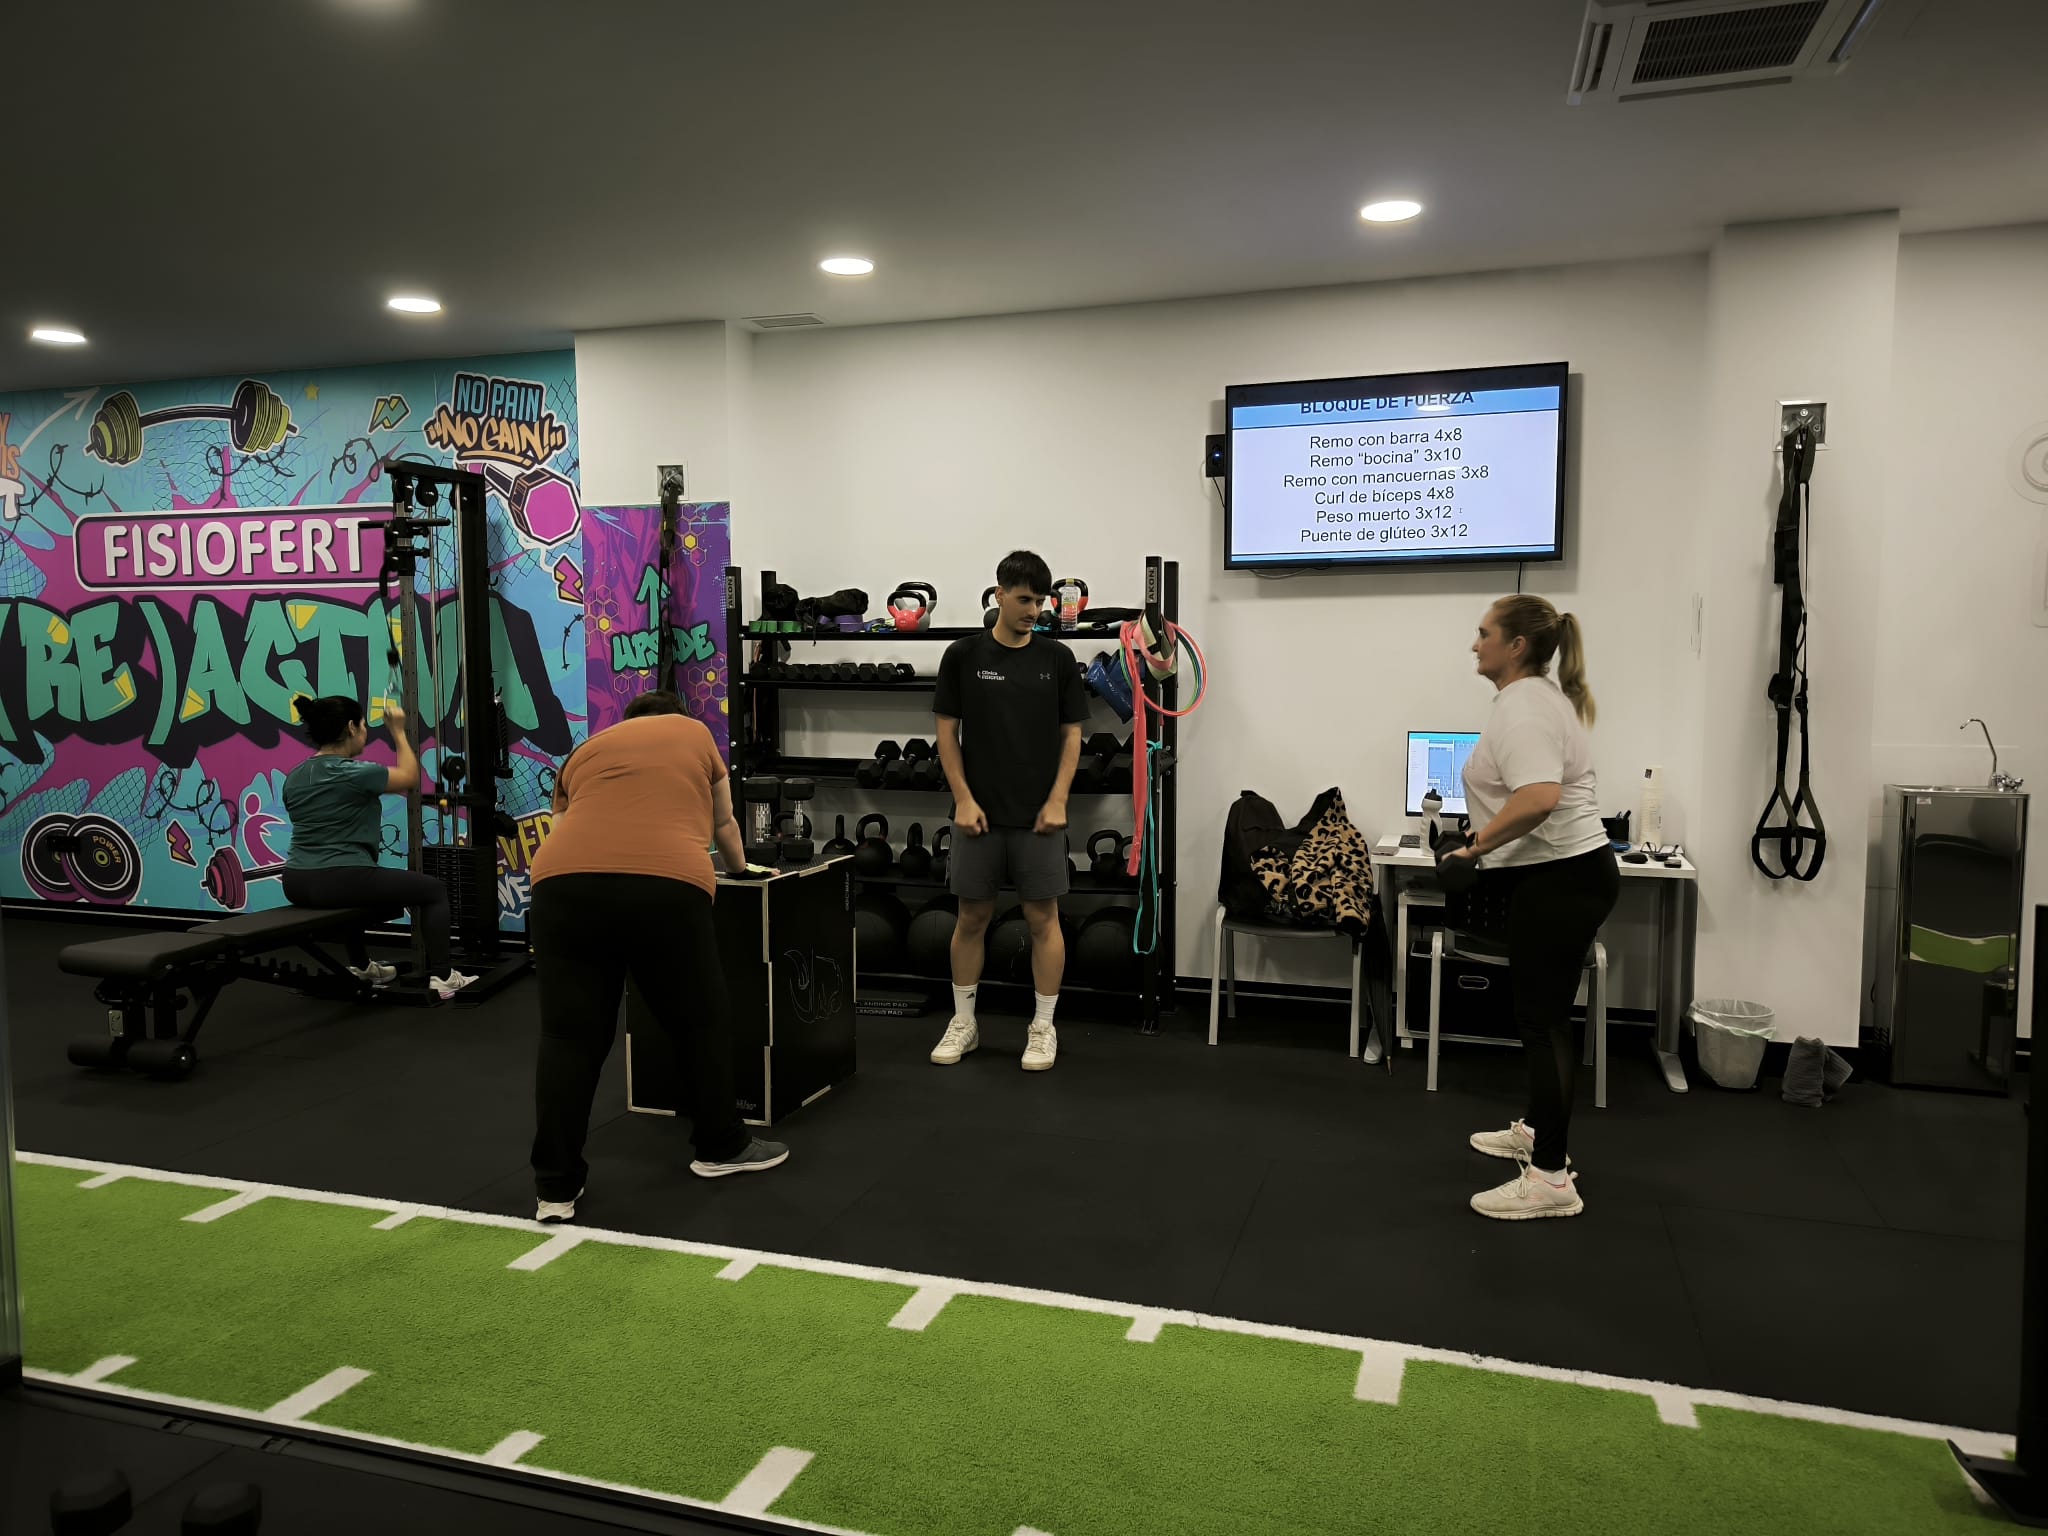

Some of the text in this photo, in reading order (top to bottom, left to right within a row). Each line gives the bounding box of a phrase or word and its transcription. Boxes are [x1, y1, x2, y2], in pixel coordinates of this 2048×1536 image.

[456, 378, 540, 422] NO PAIN
[1301, 391, 1474, 414] BLOQUE DE FUERZA
[1310, 427, 1462, 449] Remo con barra 4x8
[1310, 454, 1353, 468] Remo
[1424, 447, 1461, 462] 3x10
[1283, 465, 1489, 488] Remo con mancuernas 3x8
[1315, 486, 1454, 505] Curl de bíceps 4x8
[1316, 505, 1452, 523] Peso muerto 3x12
[1301, 523, 1468, 543] Puente de glúteo 3x12
[103, 516, 370, 577] FISIOFERT
[612, 623, 715, 671] UPSDE
[92, 835, 122, 864] POWER
